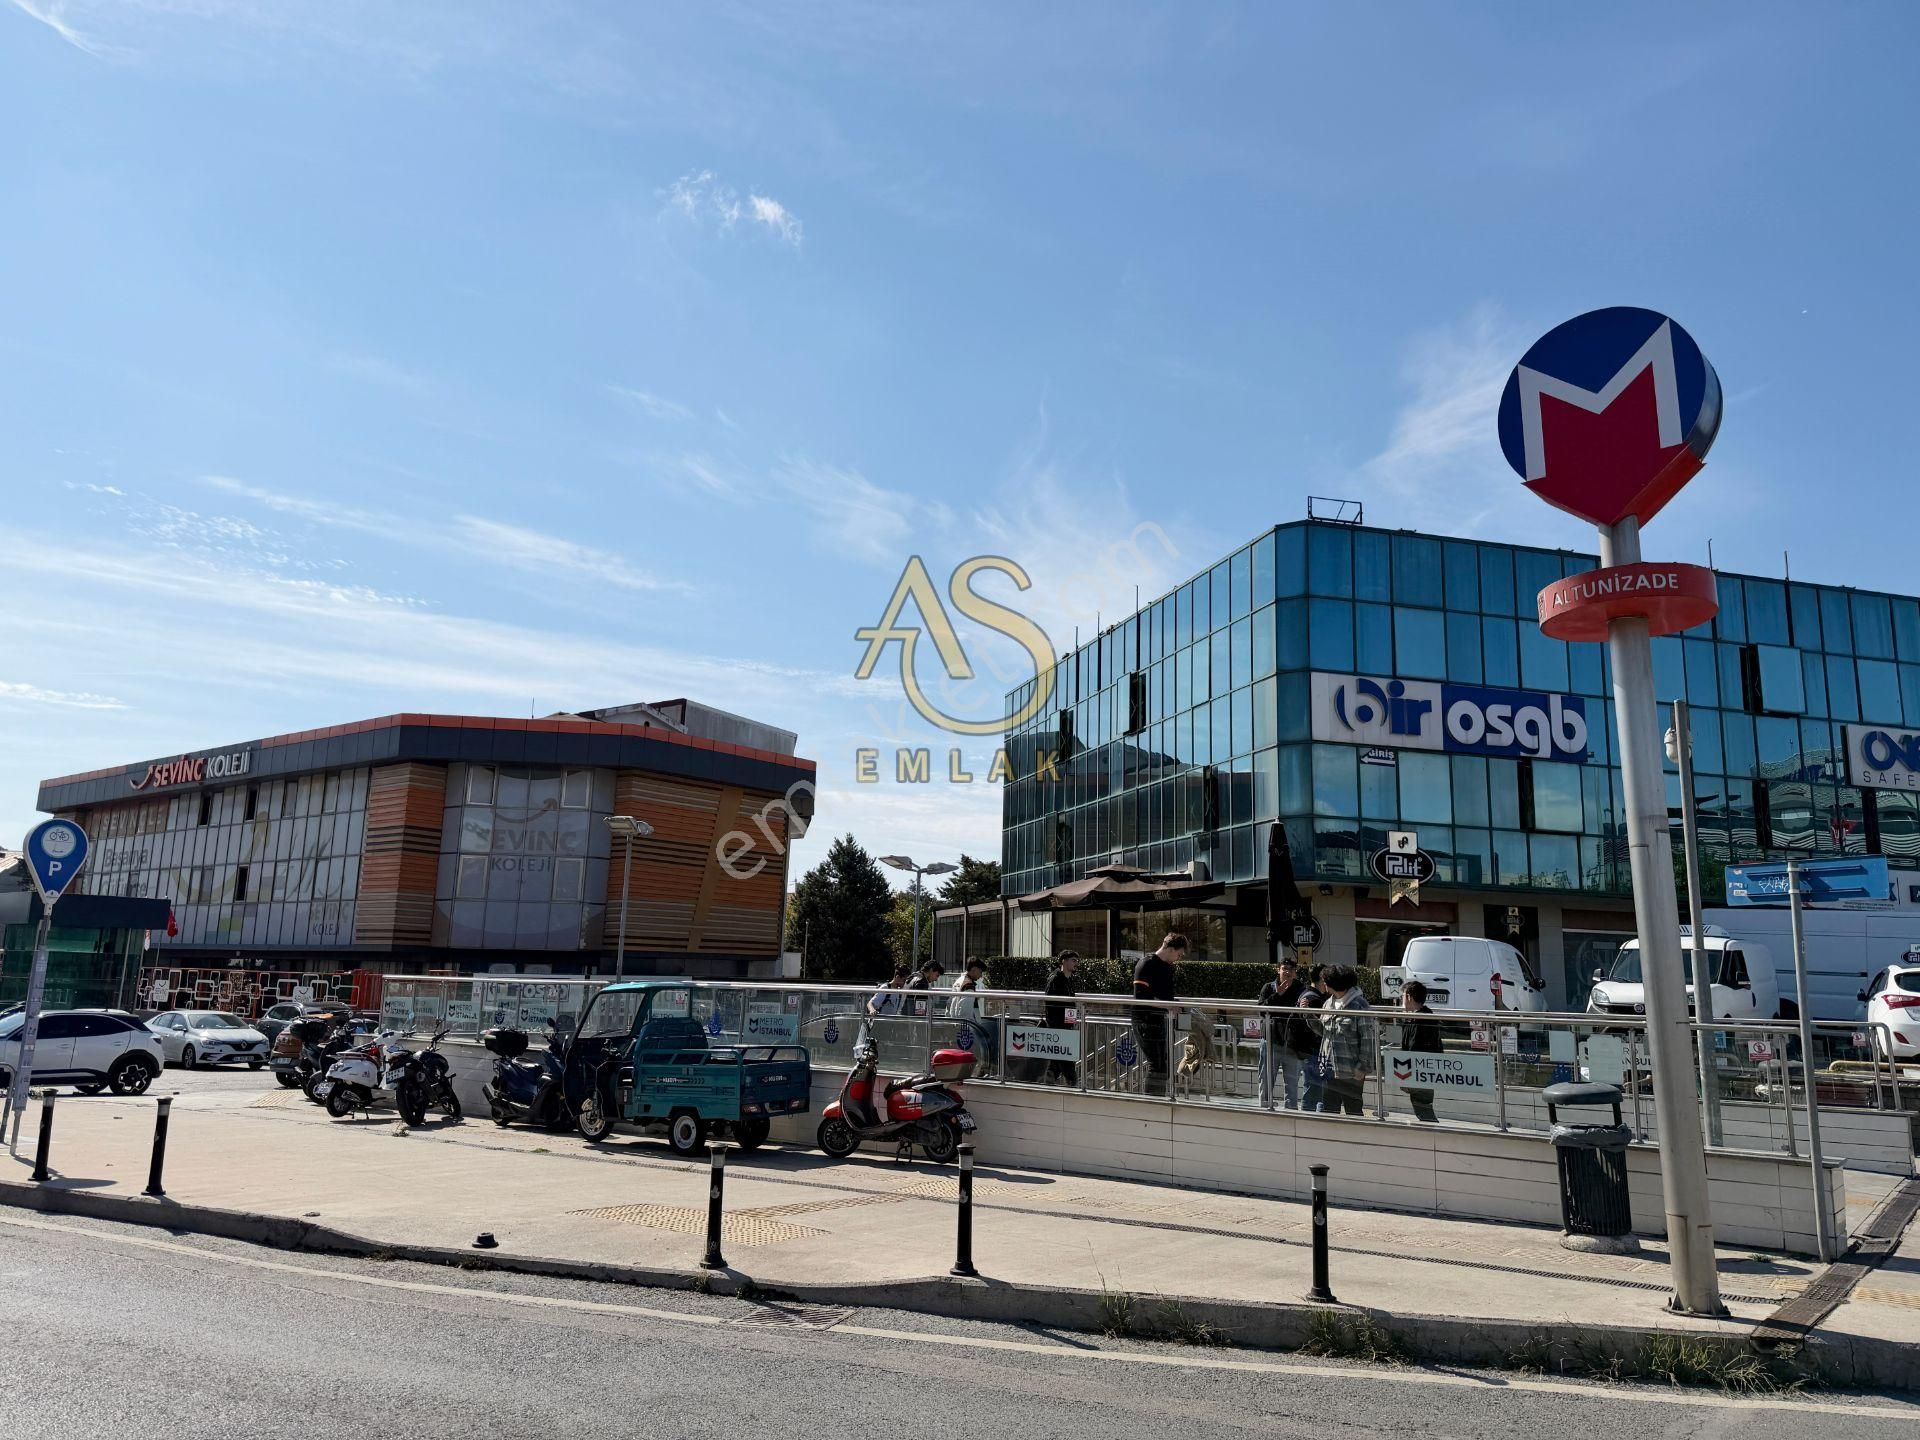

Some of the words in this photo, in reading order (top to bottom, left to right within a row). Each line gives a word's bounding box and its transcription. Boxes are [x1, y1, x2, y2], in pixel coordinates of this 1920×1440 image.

[1552, 573, 1679, 609] ALTUNİZADE
[1334, 678, 1433, 736] bir
[1446, 694, 1588, 759] osgb
[206, 746, 252, 779] KOLEJİ
[48, 861, 62, 877] P
[1385, 854, 1424, 877] Pelit
[1027, 1031, 1060, 1043] METRO
[1026, 1042, 1073, 1056] İSTANBUL
[1415, 1057, 1463, 1071] METRO
[1415, 1069, 1484, 1087] İSTANBUL
